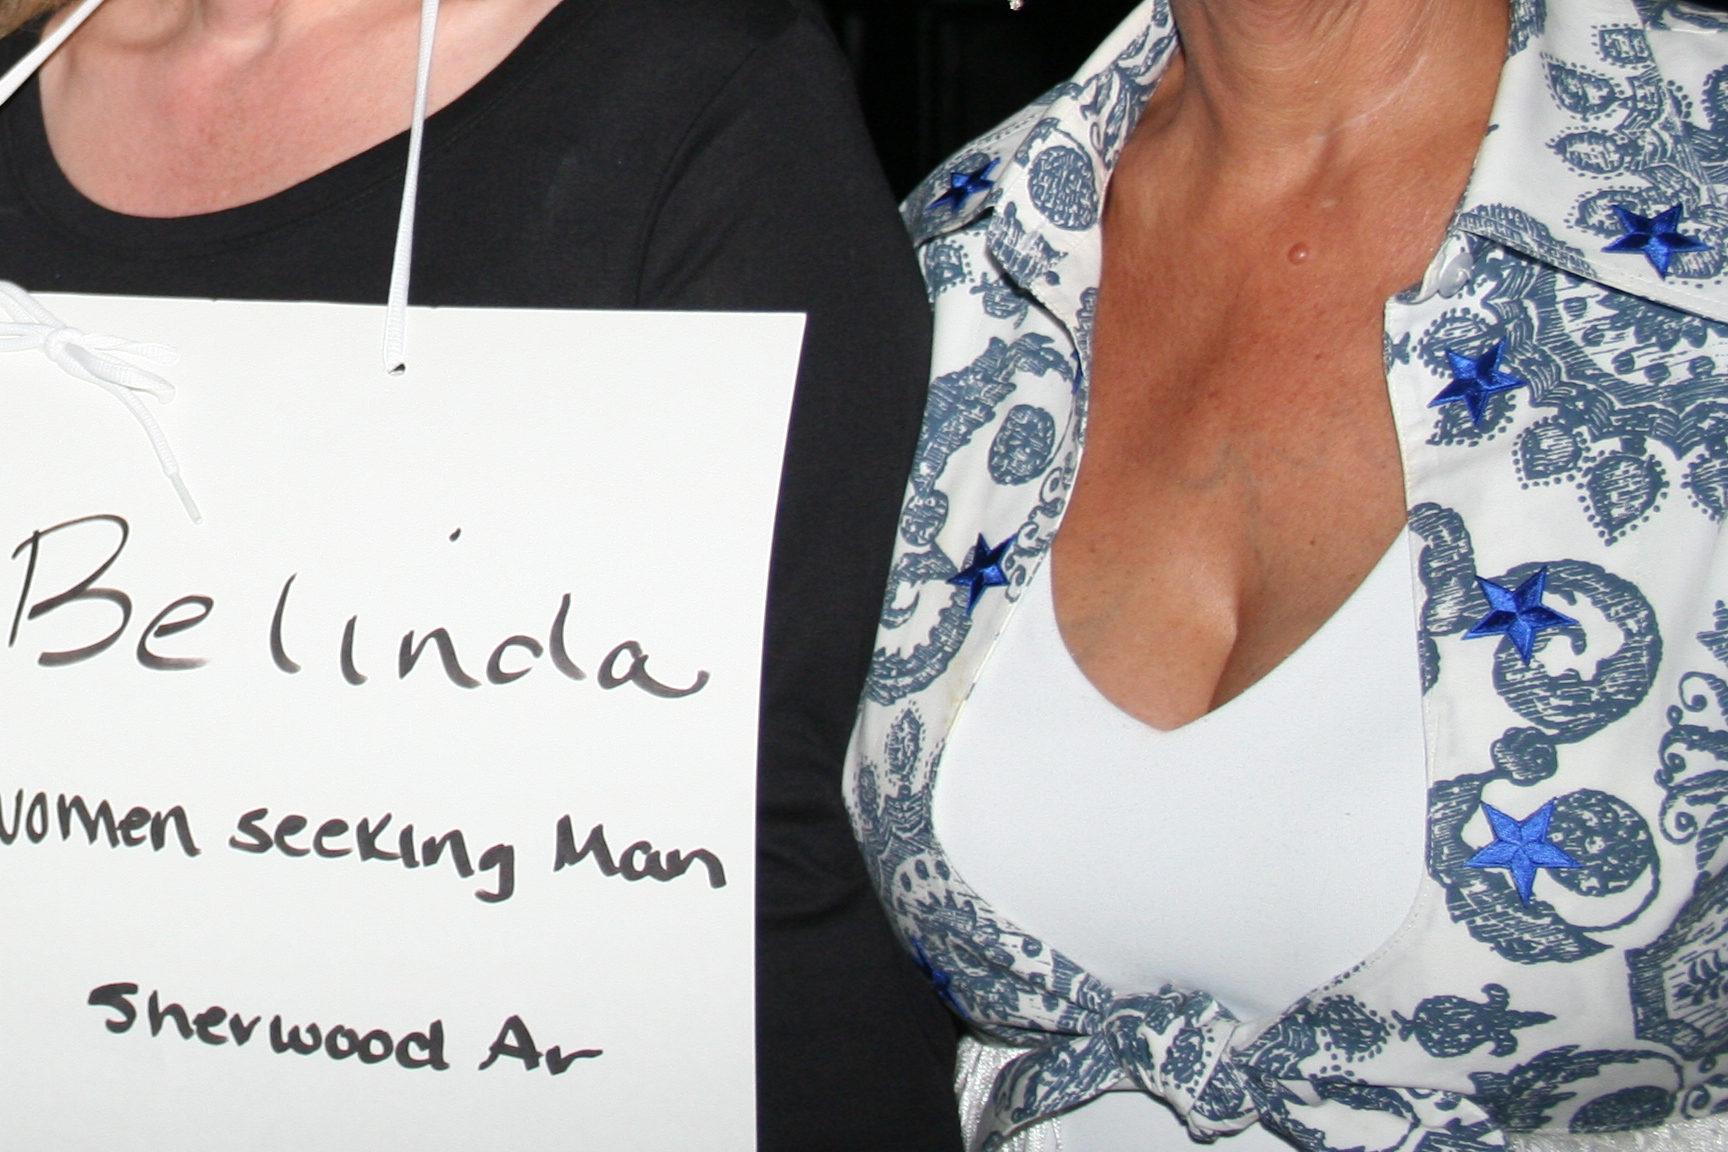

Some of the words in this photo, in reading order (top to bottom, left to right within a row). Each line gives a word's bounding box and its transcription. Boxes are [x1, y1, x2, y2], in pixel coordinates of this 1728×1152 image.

[10, 514, 709, 698] Belinda
[230, 808, 514, 903] seeking
[554, 815, 726, 888] Man
[88, 983, 449, 1070] Sherwood
[479, 1015, 602, 1075] Ar
